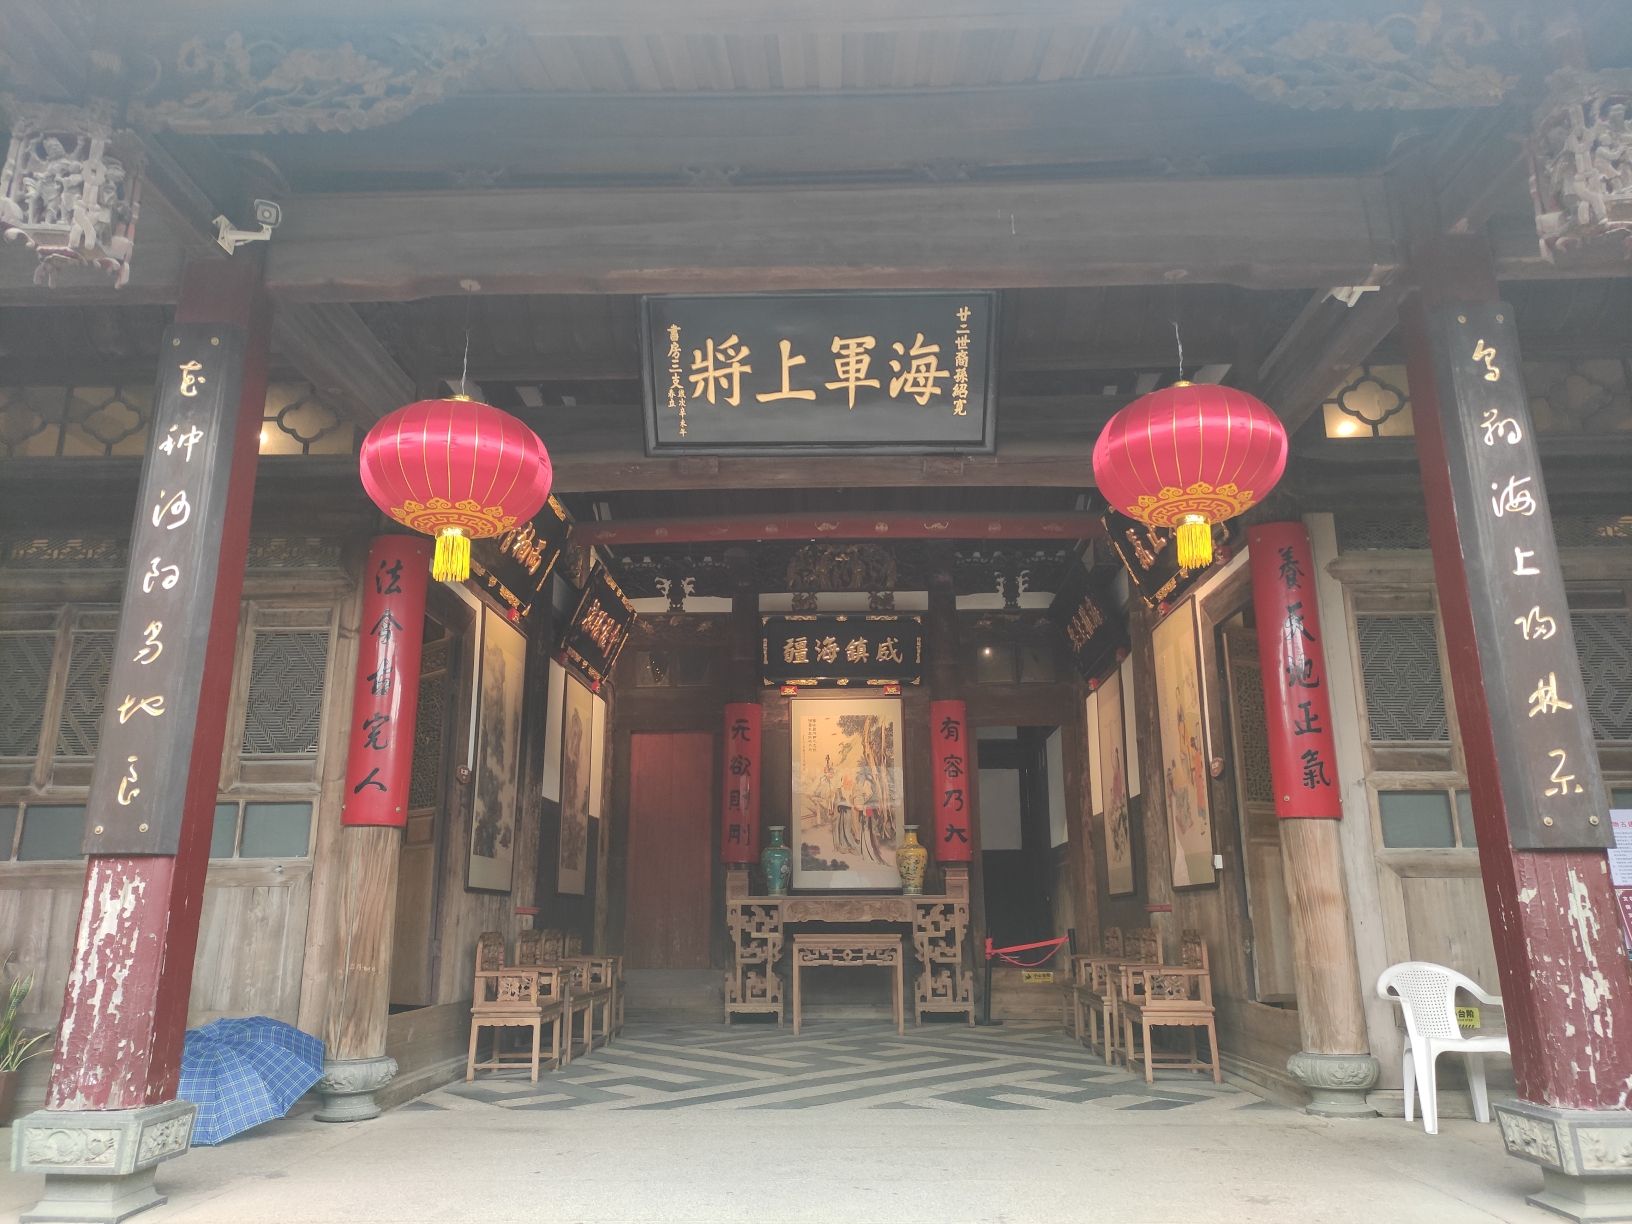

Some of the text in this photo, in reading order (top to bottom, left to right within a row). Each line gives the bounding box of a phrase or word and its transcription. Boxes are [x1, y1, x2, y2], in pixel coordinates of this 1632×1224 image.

[688, 332, 951, 411] 海軍上將
[783, 636, 903, 665] 威鎮海疆
[940, 716, 968, 843] 有容乃大
[1456, 1008, 1475, 1019] 台阶
